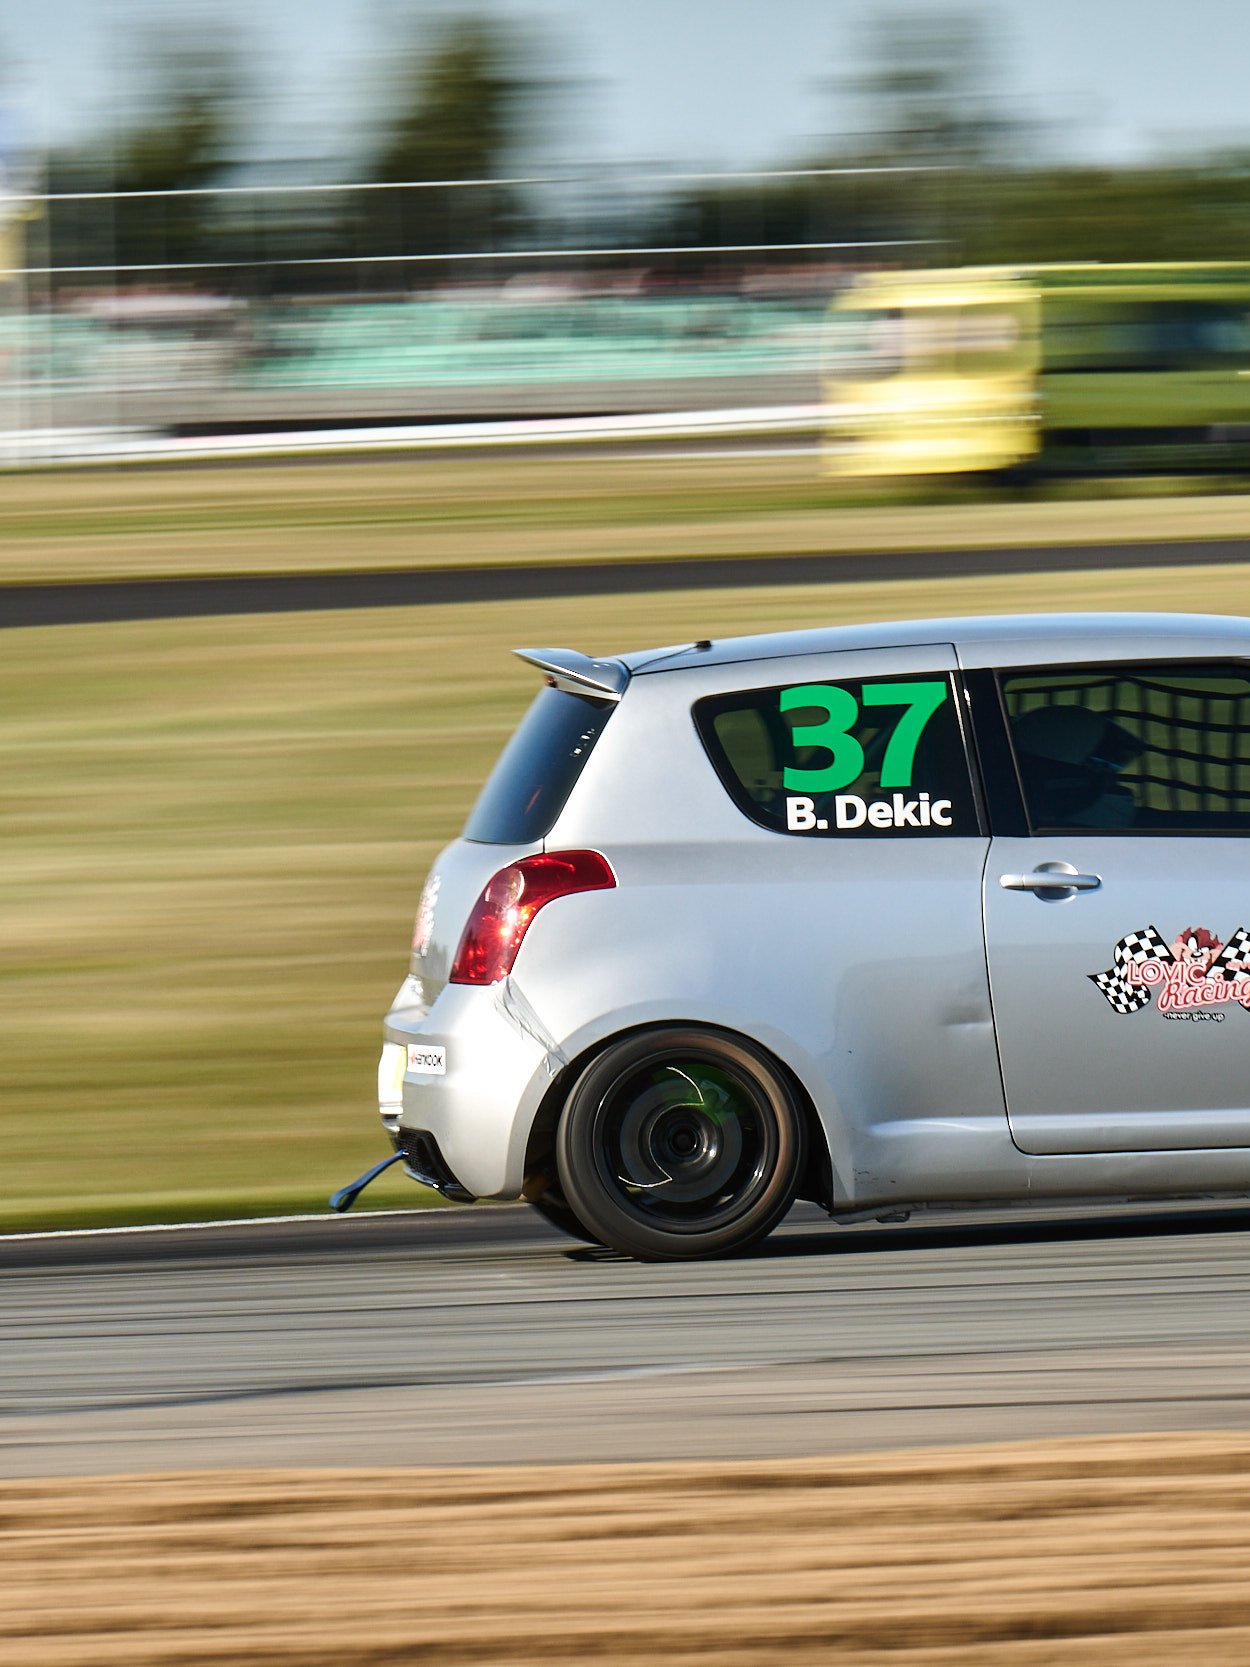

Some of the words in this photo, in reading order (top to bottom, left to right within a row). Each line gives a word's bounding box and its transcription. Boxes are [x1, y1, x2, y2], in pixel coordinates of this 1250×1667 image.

[779, 681, 947, 793] 37
[786, 796, 829, 831] B.
[835, 792, 952, 829] Dekic
[1127, 960, 1206, 986] LOVIC
[1211, 1012, 1225, 1023] up
